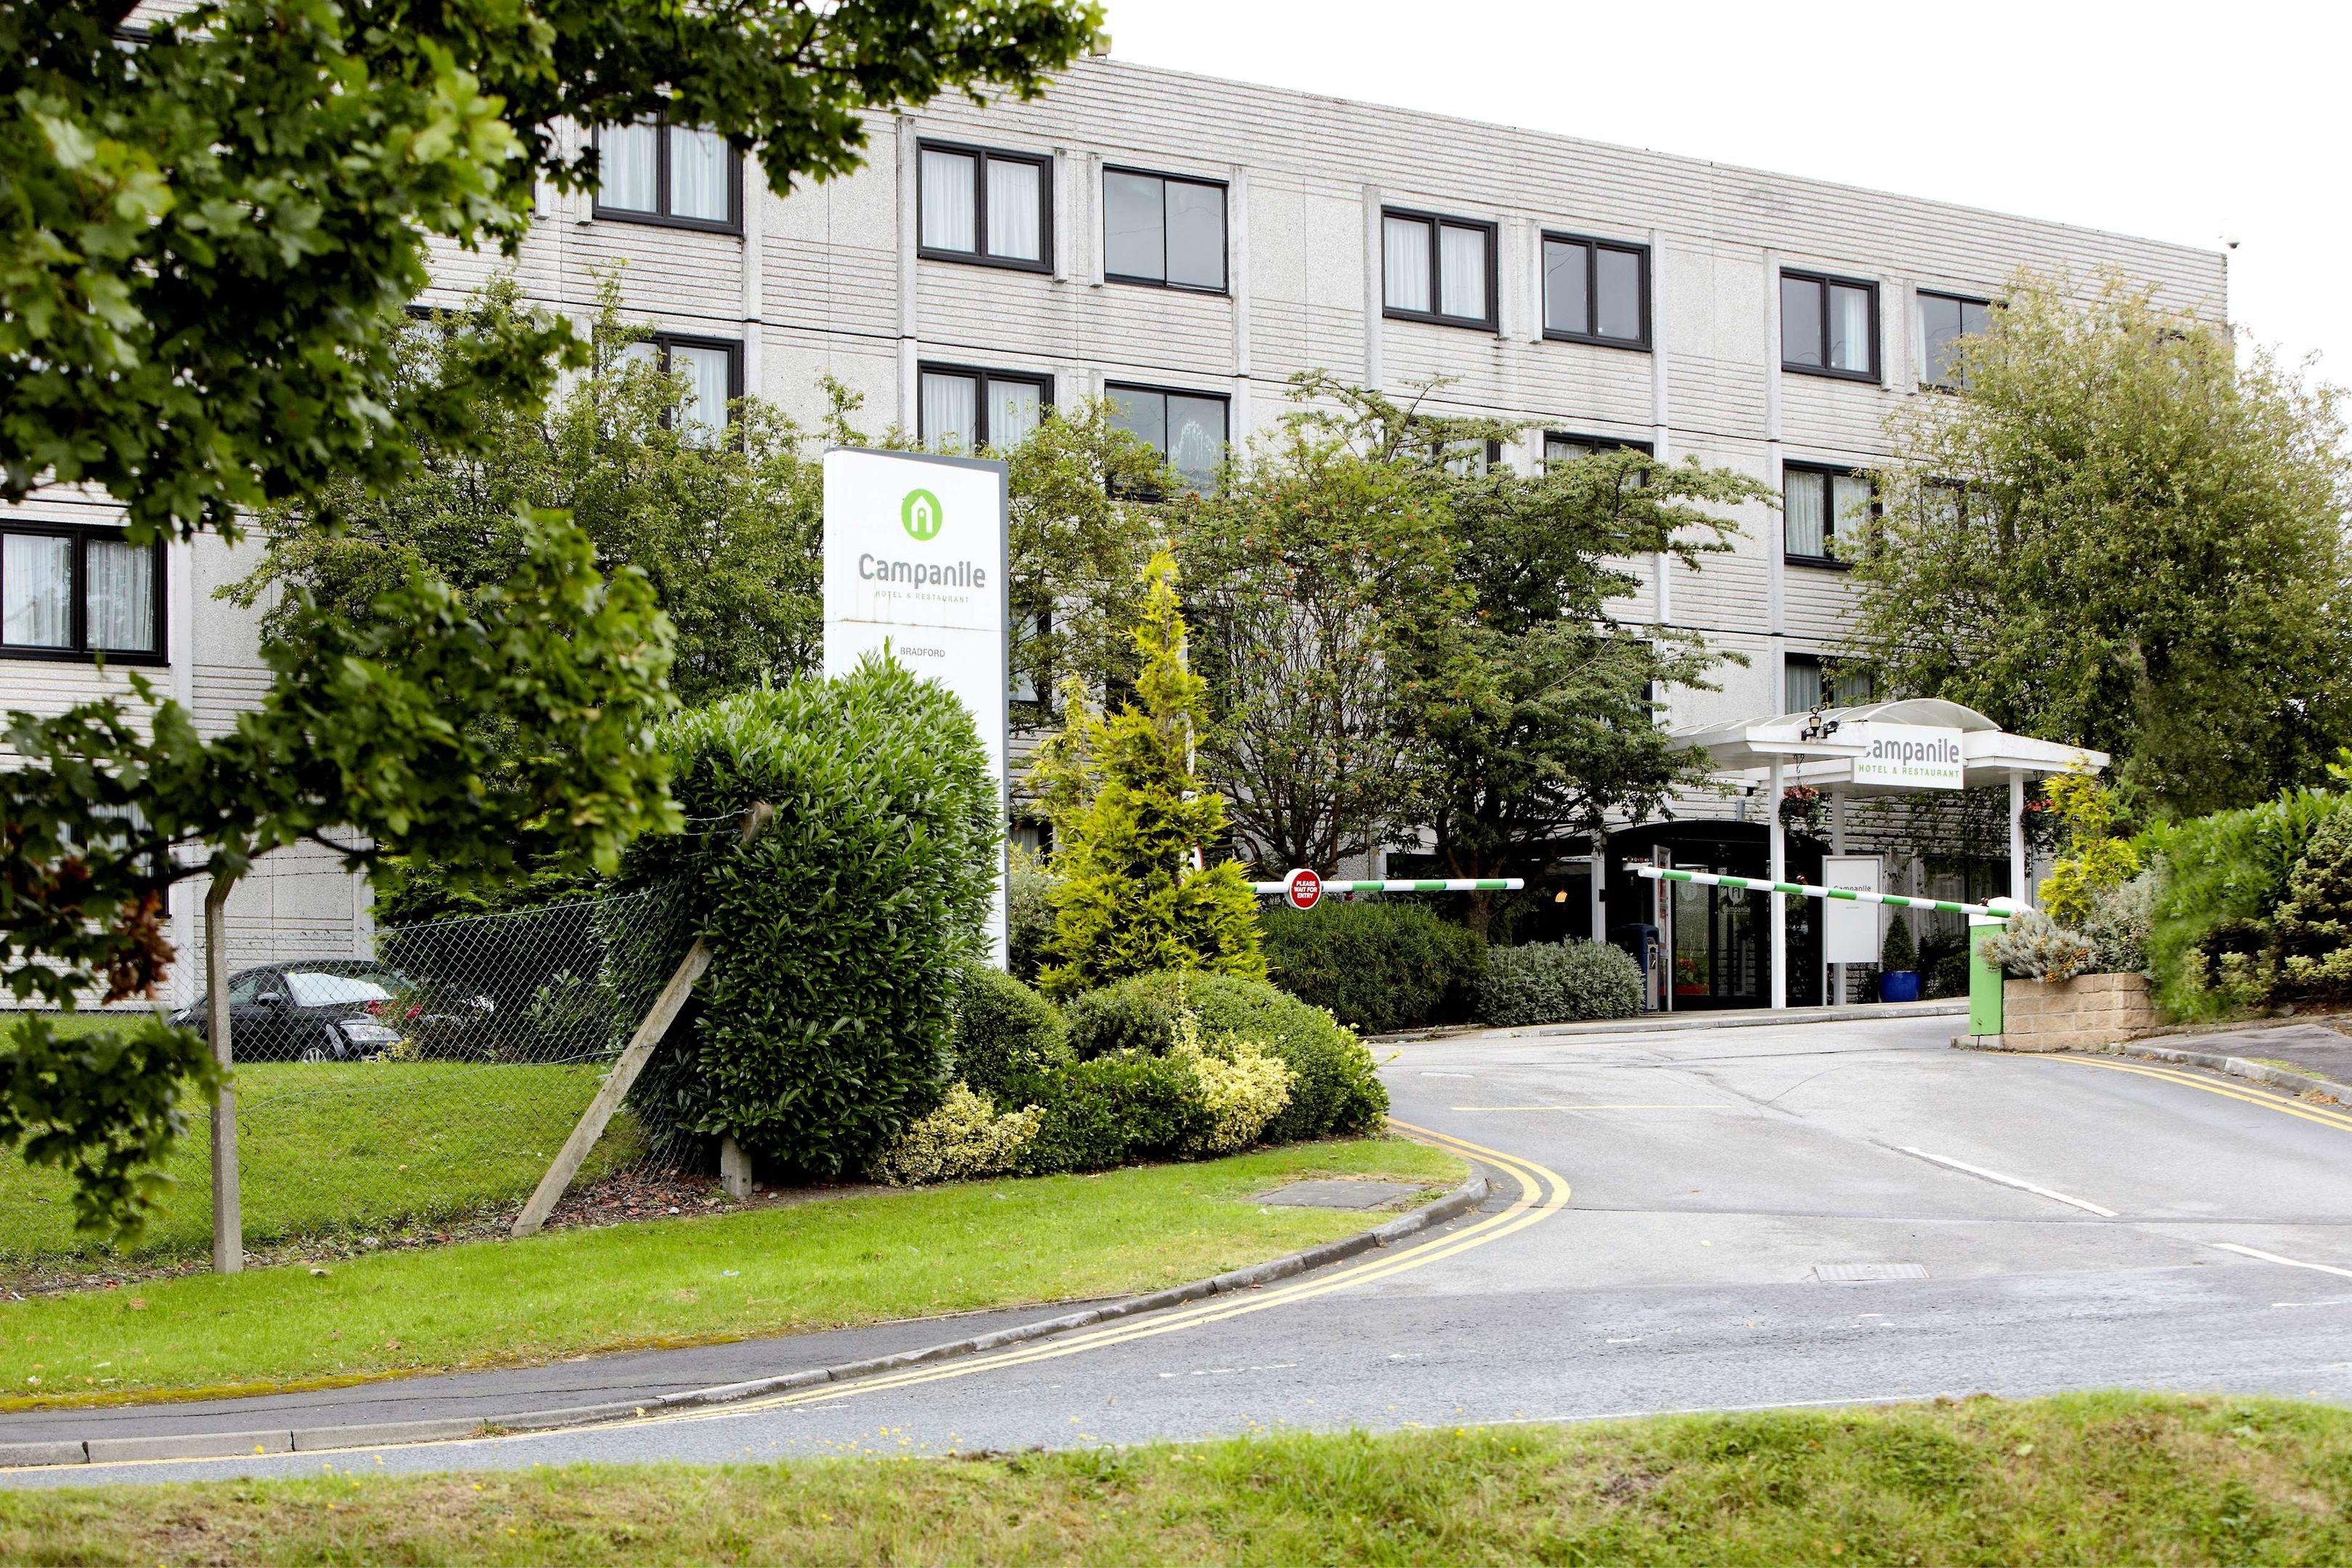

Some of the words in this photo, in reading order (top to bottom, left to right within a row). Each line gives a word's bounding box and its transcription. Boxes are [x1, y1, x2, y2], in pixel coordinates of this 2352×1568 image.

[859, 553, 986, 589] Campanile
[875, 589, 902, 599] HOTEL
[915, 592, 970, 603] RESTAURANT
[900, 646, 946, 658] BRADFORD
[1865, 738, 1959, 766] ampanile
[1859, 764, 1887, 774] HOTEL
[1902, 767, 1959, 777] RESTAURANT
